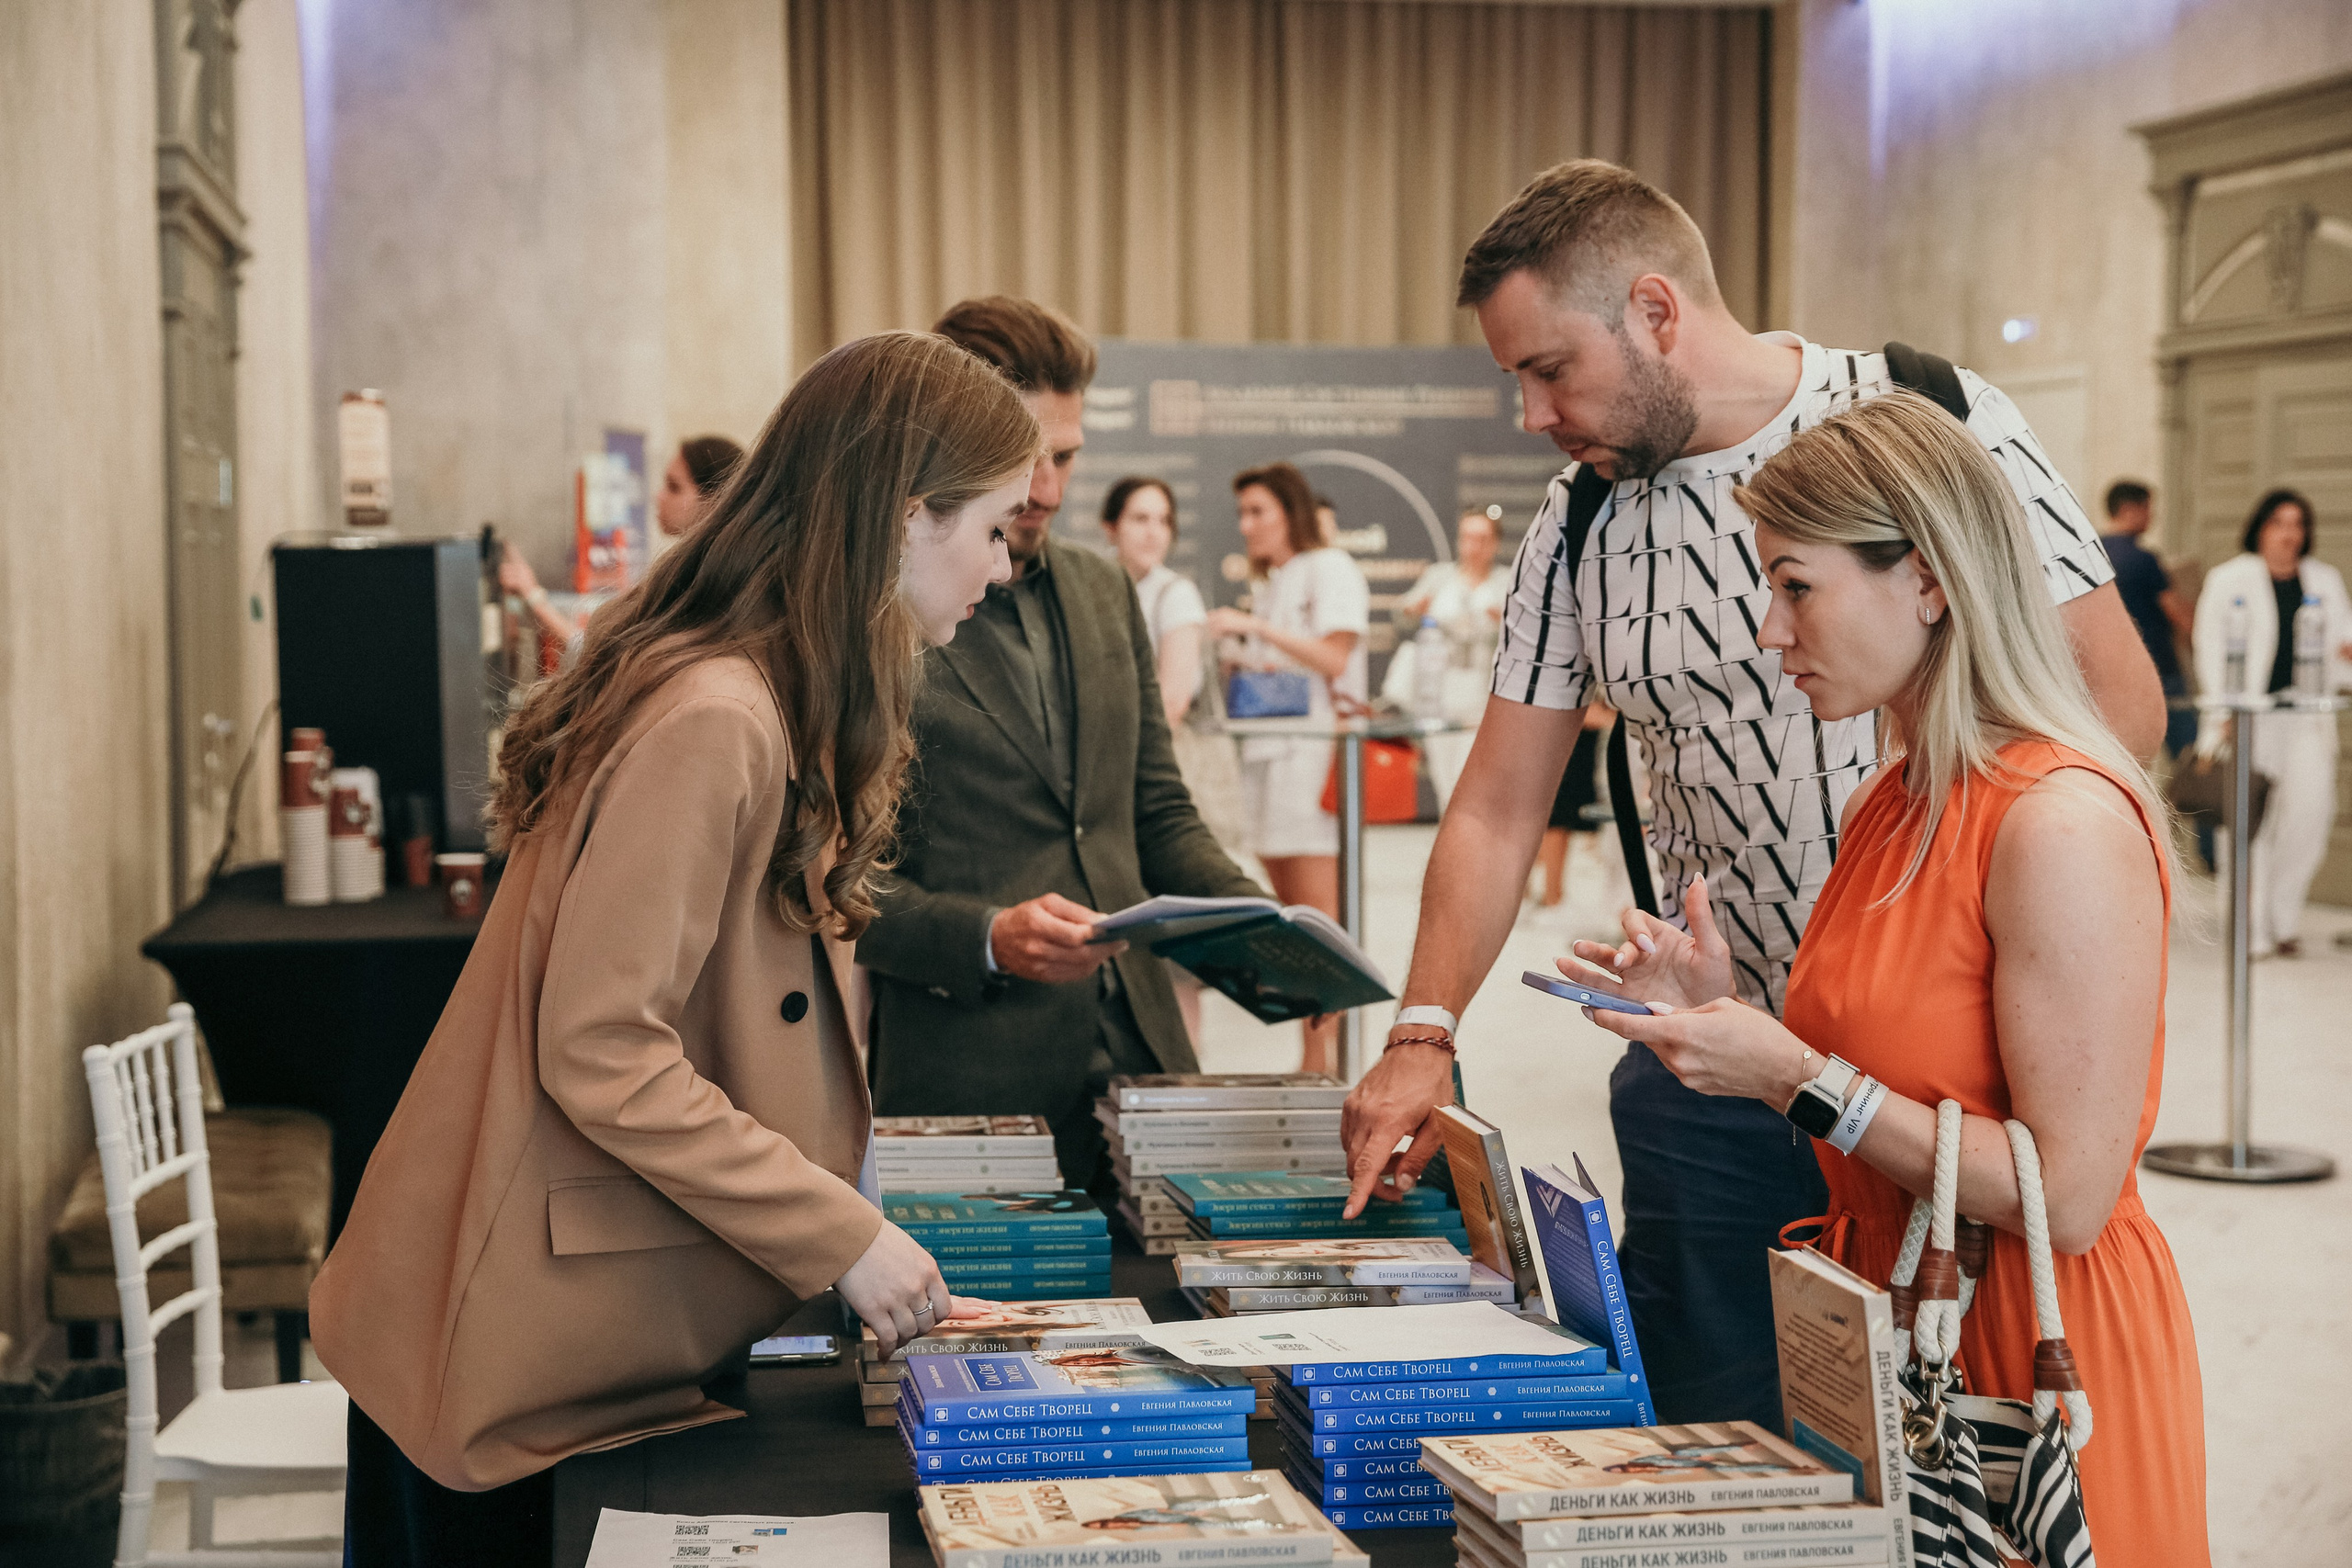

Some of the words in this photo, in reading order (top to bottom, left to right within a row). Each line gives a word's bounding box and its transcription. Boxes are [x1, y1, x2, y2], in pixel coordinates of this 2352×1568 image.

[1847, 1119, 1860, 1134] VIP
[1496, 1161, 1510, 1192] ЖИТЬ
[1504, 1194, 1518, 1227] СВОЮ
[1512, 1229, 1528, 1269] ЖИЗНЬ
[1597, 1240, 1611, 1271] САМ
[1211, 1271, 1243, 1280] ЖИТЬ
[1246, 1270, 1280, 1280] СВОЮ
[1283, 1270, 1322, 1280] ЖИЗНЬ
[1259, 1294, 1290, 1303] ЖИТЬ
[1293, 1293, 1327, 1303] СВОЮ
[1329, 1292, 1369, 1303] ЖИЗНЬ
[1605, 1273, 1620, 1305] СЕБЕ
[1612, 1306, 1633, 1358] ТВОРЕЦ
[930, 1343, 965, 1353] СВОЮ
[967, 1342, 1008, 1352] ЖИЗНЬ
[1333, 1366, 1363, 1379] САМ
[1368, 1364, 1397, 1377] СЕБЕ
[1402, 1363, 1452, 1375] ТВОРЕЦ
[1498, 1361, 1532, 1370] ЕВГЕНИЯ
[1534, 1359, 1585, 1368] ПАВЛОВСКАЯ
[1876, 1350, 1894, 1408] ДЕНЬГИ
[1350, 1389, 1381, 1402] САМ
[1385, 1388, 1416, 1401] СЕБЕ
[1419, 1387, 1471, 1399] ТВОРЕЦ
[1517, 1386, 1551, 1394] ЕВГЕНИЯ
[1554, 1384, 1605, 1393] ПАВЛОВСКАЯ
[967, 1406, 999, 1419] САМ
[1003, 1404, 1035, 1418] СЕБЕ
[1039, 1404, 1092, 1416] ТВОРЕЦ
[1141, 1402, 1176, 1410] ЕВГЕНИЯ
[1179, 1399, 1232, 1408] ПАВЛОВСКАЯ
[1355, 1414, 1385, 1426] САМ
[1389, 1412, 1420, 1425] СЕБЕ
[1424, 1411, 1476, 1424] ТВОРЕЦ
[1522, 1411, 1556, 1419] ЕВГЕНИЯ
[1559, 1409, 1611, 1417] ПАВЛОВСКАЯ
[1637, 1402, 1648, 1427] ЕВГЕН
[958, 1429, 989, 1442] САМ
[994, 1427, 1026, 1440] СЕБЕ
[1030, 1426, 1083, 1438] ТВОРЕЦ
[1132, 1425, 1167, 1433] ЕВГЕНИЯ
[1170, 1423, 1223, 1431] ПАВЛОВСКАЯ
[1883, 1412, 1898, 1443] КАК
[1354, 1438, 1385, 1450] САМ
[1388, 1438, 1419, 1450] СЕБЕ
[960, 1454, 992, 1467] САМ
[996, 1452, 1028, 1465] СЕБЕ
[1032, 1450, 1085, 1463] ТВОРЕЦ
[1134, 1449, 1169, 1457] ЕВГЕНИЯ
[1171, 1446, 1225, 1455] ПАВЛОВСКАЯ
[1364, 1462, 1395, 1475] САМ
[1399, 1461, 1427, 1473] СЕБ
[1886, 1446, 1903, 1502] ЖИЗНЬ
[1364, 1486, 1395, 1498] САМ
[1399, 1484, 1430, 1496] СЕБЕ
[1549, 1495, 1605, 1512] ДЕНЬГИ
[1610, 1492, 1639, 1507] КАК
[1644, 1490, 1695, 1506] ЖИЗНЬ
[1711, 1490, 1754, 1501] ЕВГЕНИЯ
[1757, 1486, 1819, 1498] ПАВЛОВСКАЯ
[1363, 1510, 1394, 1523] САМ
[1398, 1509, 1429, 1522] СЕБЕ
[1577, 1526, 1634, 1543] ДЕНЬГИ
[1638, 1524, 1668, 1539] КАК
[1672, 1521, 1725, 1537] ЖИЗНЬ
[1742, 1522, 1785, 1534] ЕВГЕНИЯ
[1788, 1519, 1853, 1531] ПАВЛОВСКАЯ
[1894, 1517, 1906, 1564] ЕВГЕНИЯ
[1003, 1551, 1064, 1568] ДЕНЬГИ
[1069, 1551, 1099, 1567] КАК
[1104, 1548, 1161, 1565] ЖИЗНЬ
[1580, 1554, 1637, 1568] ДЕНЬГИ
[1641, 1551, 1670, 1567] КАК
[1674, 1550, 1727, 1565] ЖИЗНЬ
[1744, 1549, 1786, 1561] ЕВГЕНИЯ
[1789, 1545, 1854, 1558] ПАВЛОВСКАЯ
